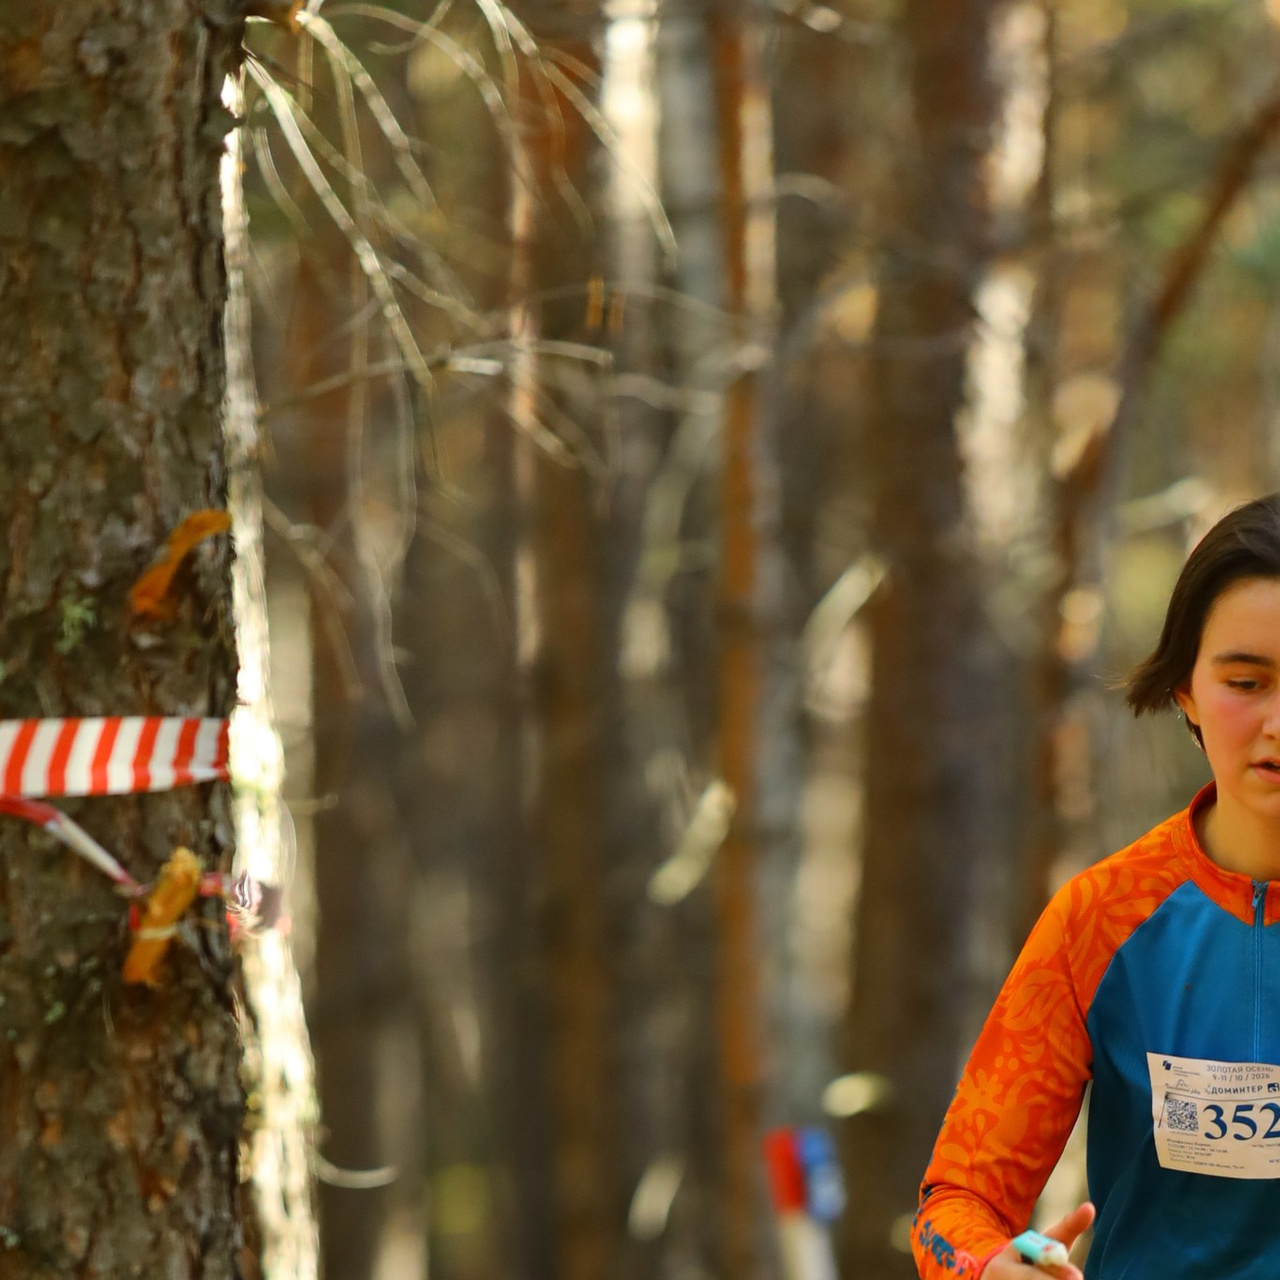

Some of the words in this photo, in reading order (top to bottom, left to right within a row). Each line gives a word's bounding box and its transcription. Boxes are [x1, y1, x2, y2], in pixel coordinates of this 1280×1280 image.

[1206, 1064, 1243, 1074] ЗОЛОТАЯ
[1245, 1065, 1274, 1073] ОСЕНЬ
[1212, 1073, 1227, 1081] 9-11
[1211, 1085, 1263, 1095] ДОМИНТЕР
